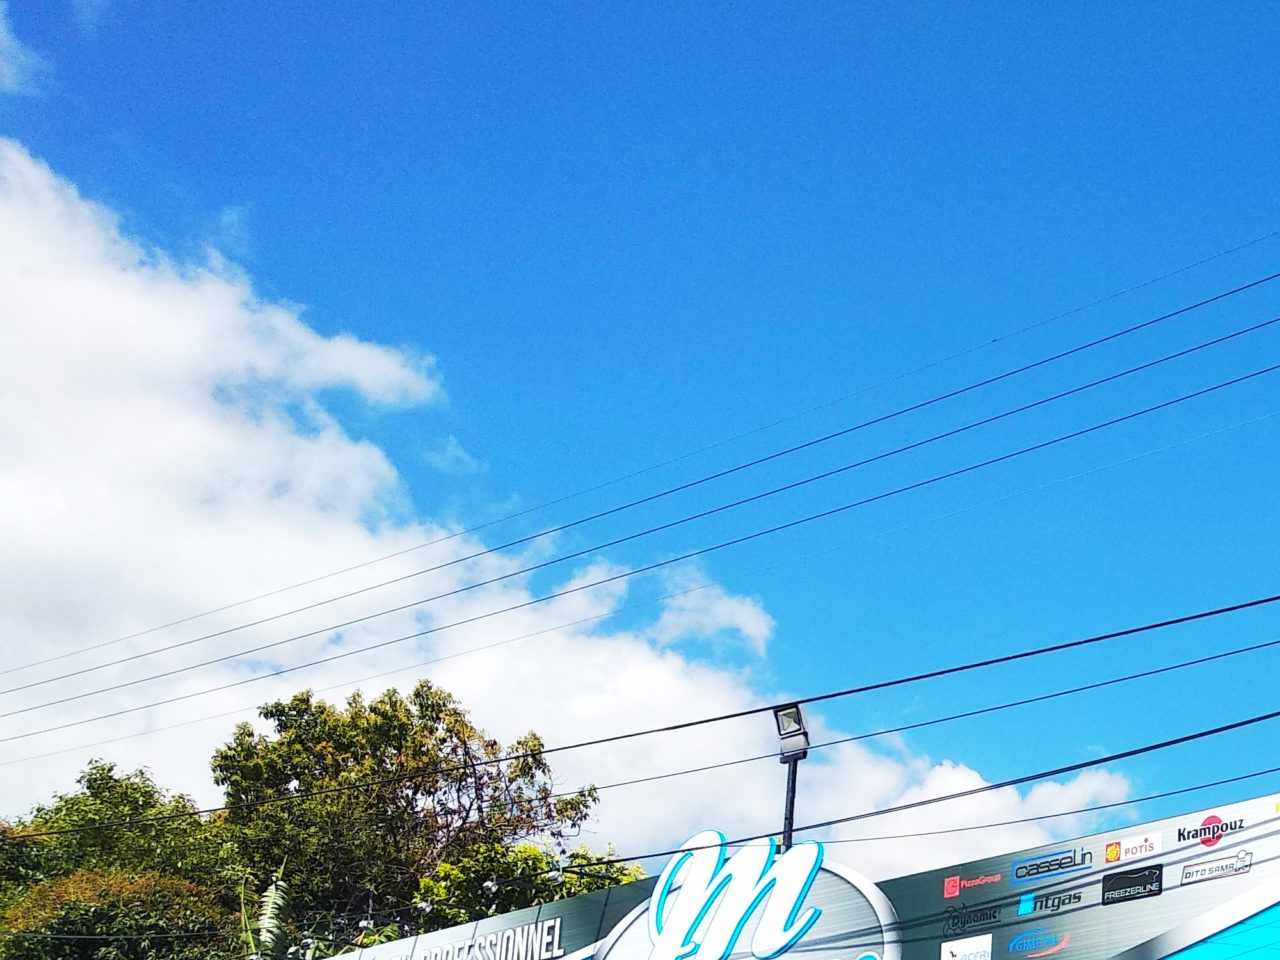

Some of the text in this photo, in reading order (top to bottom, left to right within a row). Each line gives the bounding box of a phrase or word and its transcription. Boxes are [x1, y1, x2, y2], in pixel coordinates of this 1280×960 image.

[1177, 818, 1245, 843] Krampouz
[1124, 837, 1154, 857] POTIS
[960, 873, 1001, 889] PizzaGroup
[1185, 867, 1207, 880] DITO
[1104, 881, 1160, 900] FREEZERLINE
[951, 907, 998, 931] Dynamic
